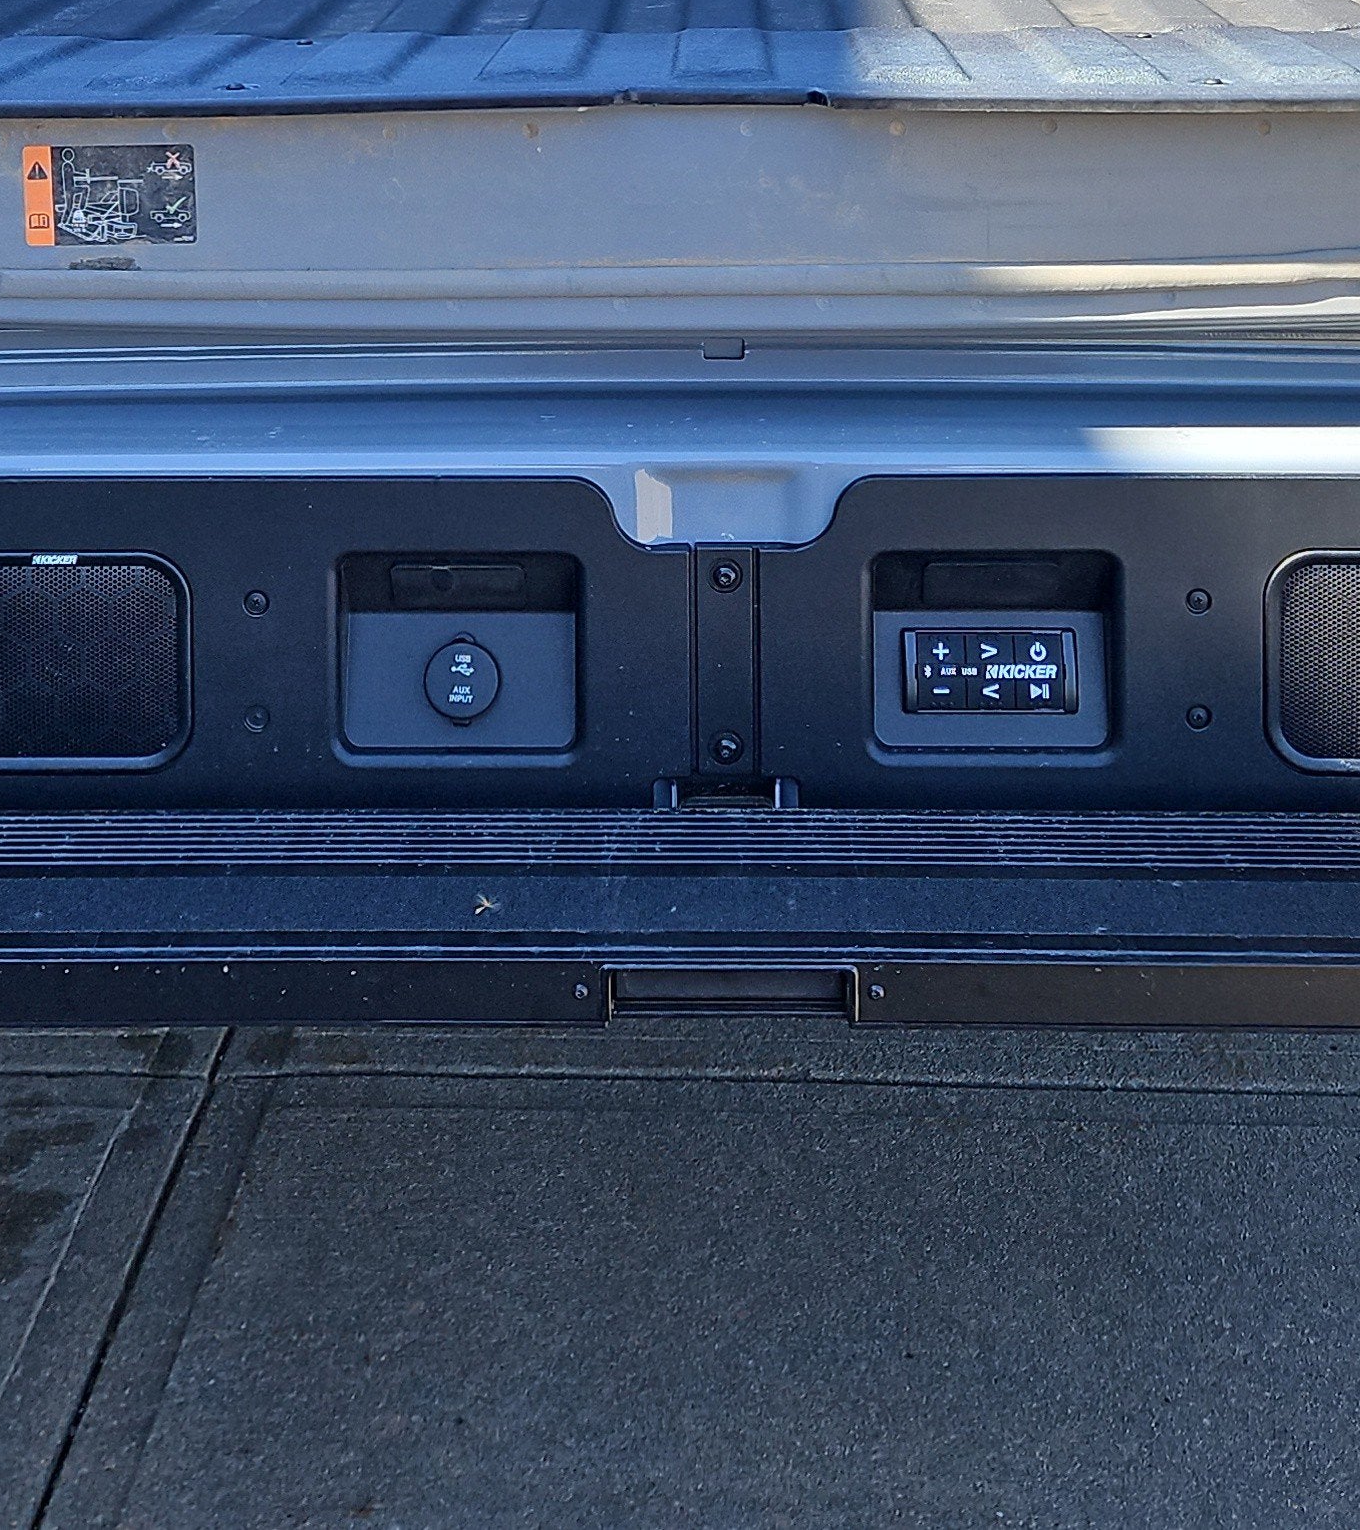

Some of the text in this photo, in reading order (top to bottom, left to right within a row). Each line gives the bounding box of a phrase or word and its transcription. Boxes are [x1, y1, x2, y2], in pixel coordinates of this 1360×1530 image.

[40, 554, 78, 565] KICKER
[454, 654, 472, 663] USB
[940, 665, 978, 676] AUX USB
[996, 664, 1058, 680] KICKER
[452, 685, 471, 695] AUX
[448, 694, 474, 704] INPUT
